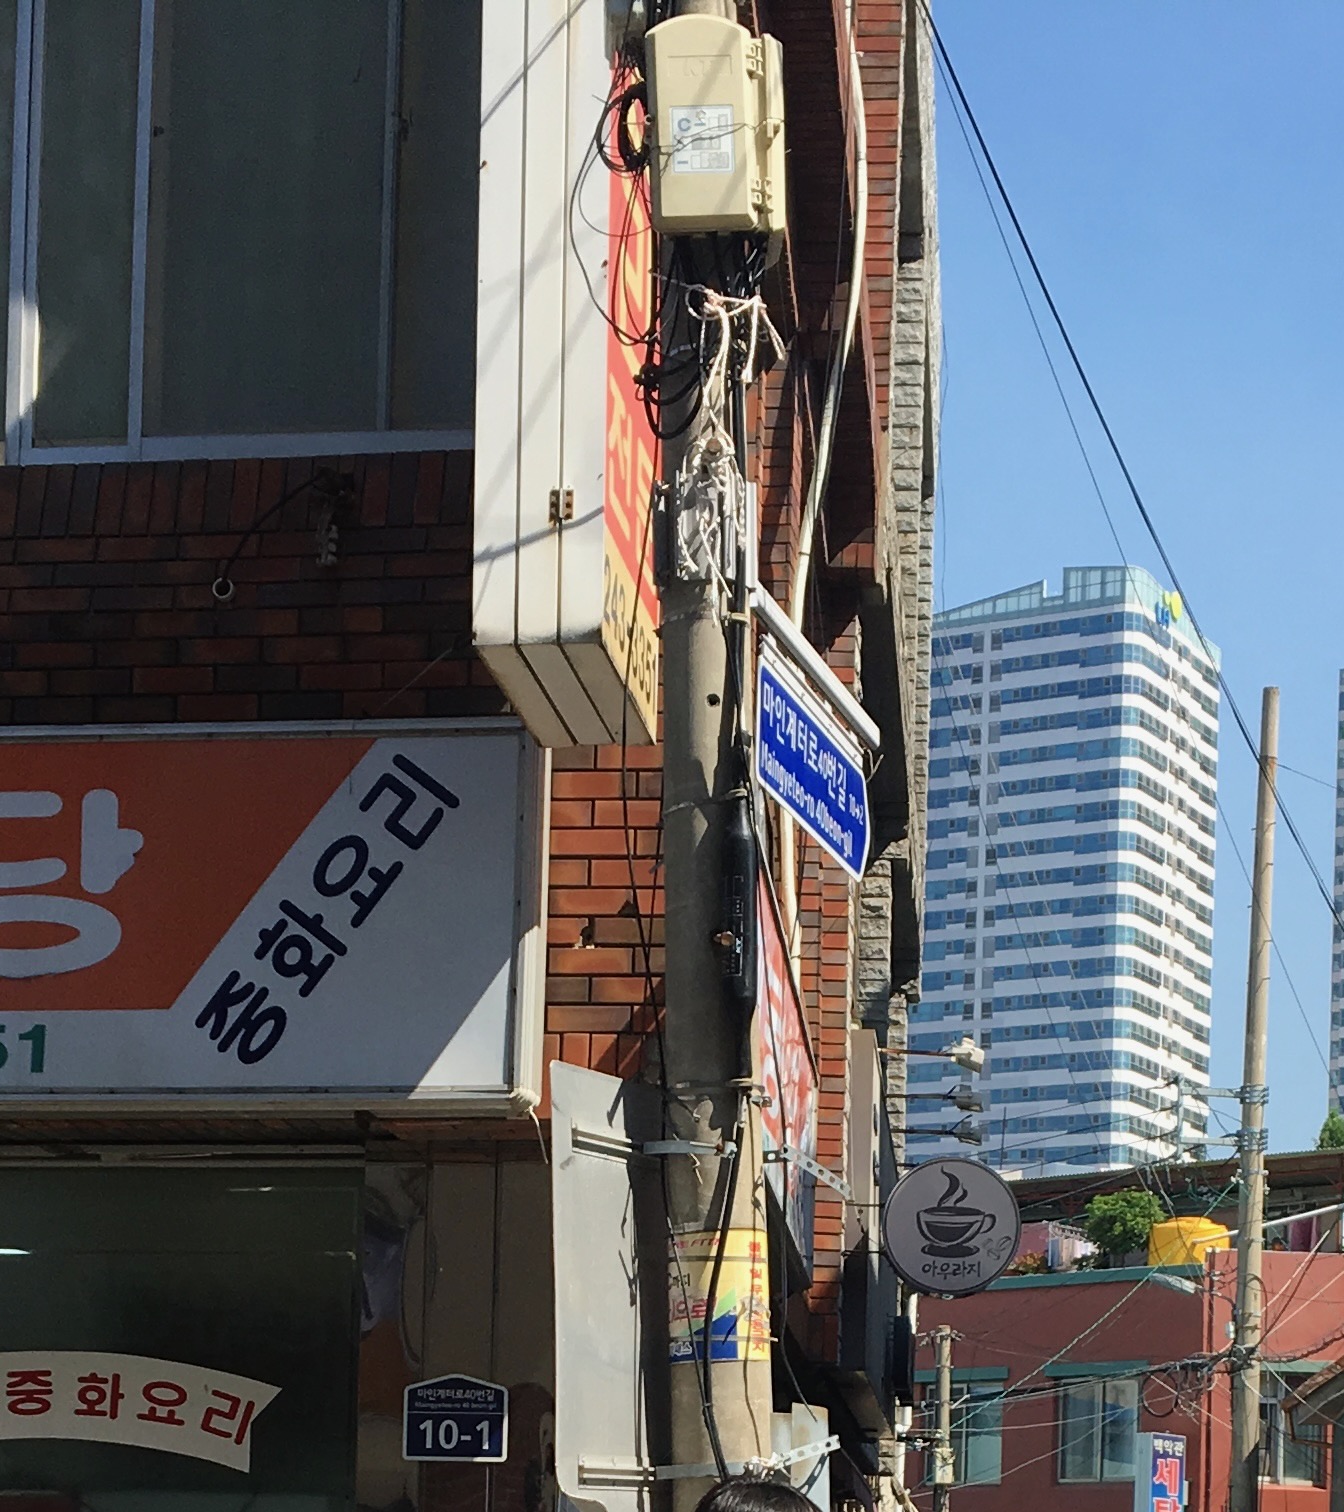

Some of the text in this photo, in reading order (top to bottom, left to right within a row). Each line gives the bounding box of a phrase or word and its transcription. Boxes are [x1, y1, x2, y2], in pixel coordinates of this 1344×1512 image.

[762, 680, 847, 812] 마인계터로40번길
[194, 752, 462, 1066] 중화요리
[921, 1260, 982, 1280] 아우라지
[418, 1418, 490, 1451] 10-1
[1153, 1438, 1185, 1457] 백악관
